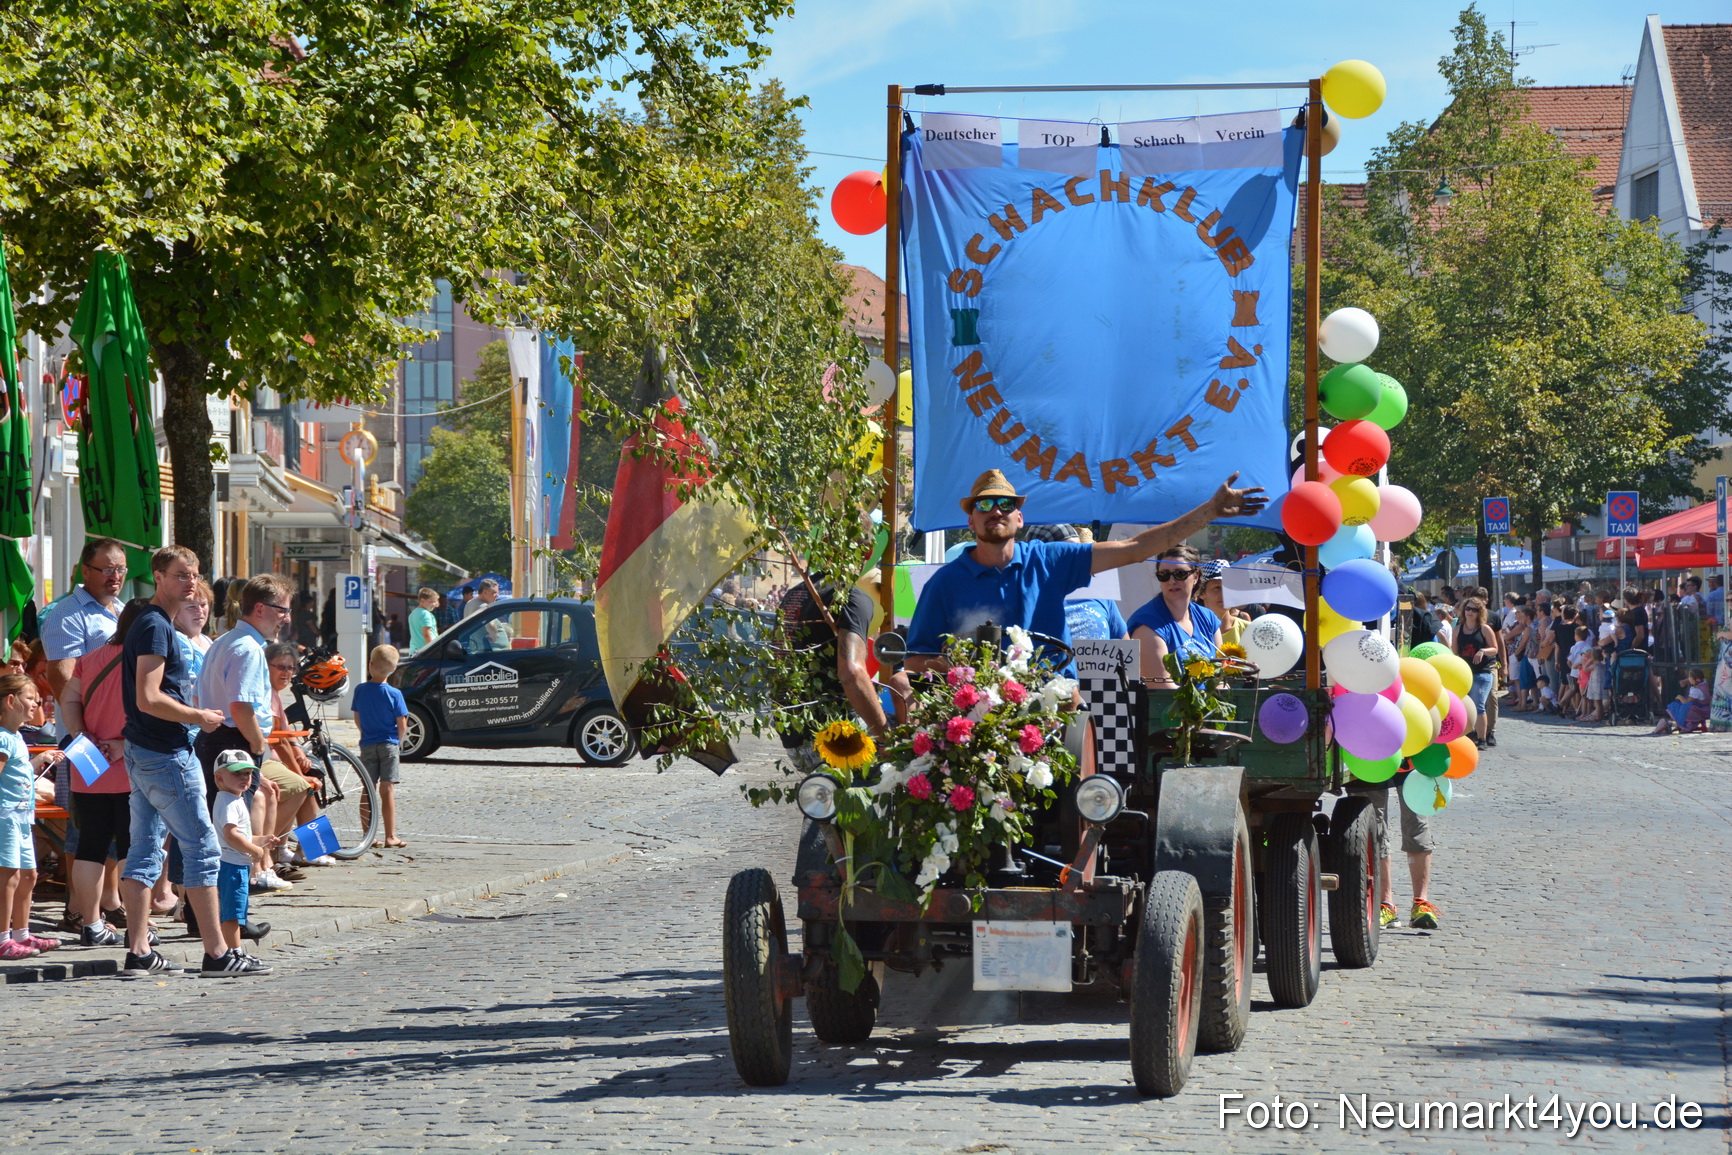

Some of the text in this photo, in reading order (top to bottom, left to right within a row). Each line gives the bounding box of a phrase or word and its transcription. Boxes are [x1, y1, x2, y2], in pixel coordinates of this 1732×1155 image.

[924, 126, 1266, 149] Deutscher TOP Schach Verein
[948, 169, 1255, 298] SCHACHKLUB
[952, 350, 1199, 494] NEUMARKT
[1487, 522, 1508, 531] TAXI
[1610, 523, 1635, 533] TAXI
[1250, 576, 1276, 585] ma!
[446, 669, 518, 684] nm-immobilien
[458, 698, 480, 706] 09181
[487, 677, 560, 725] www.nm-immobilien.de
